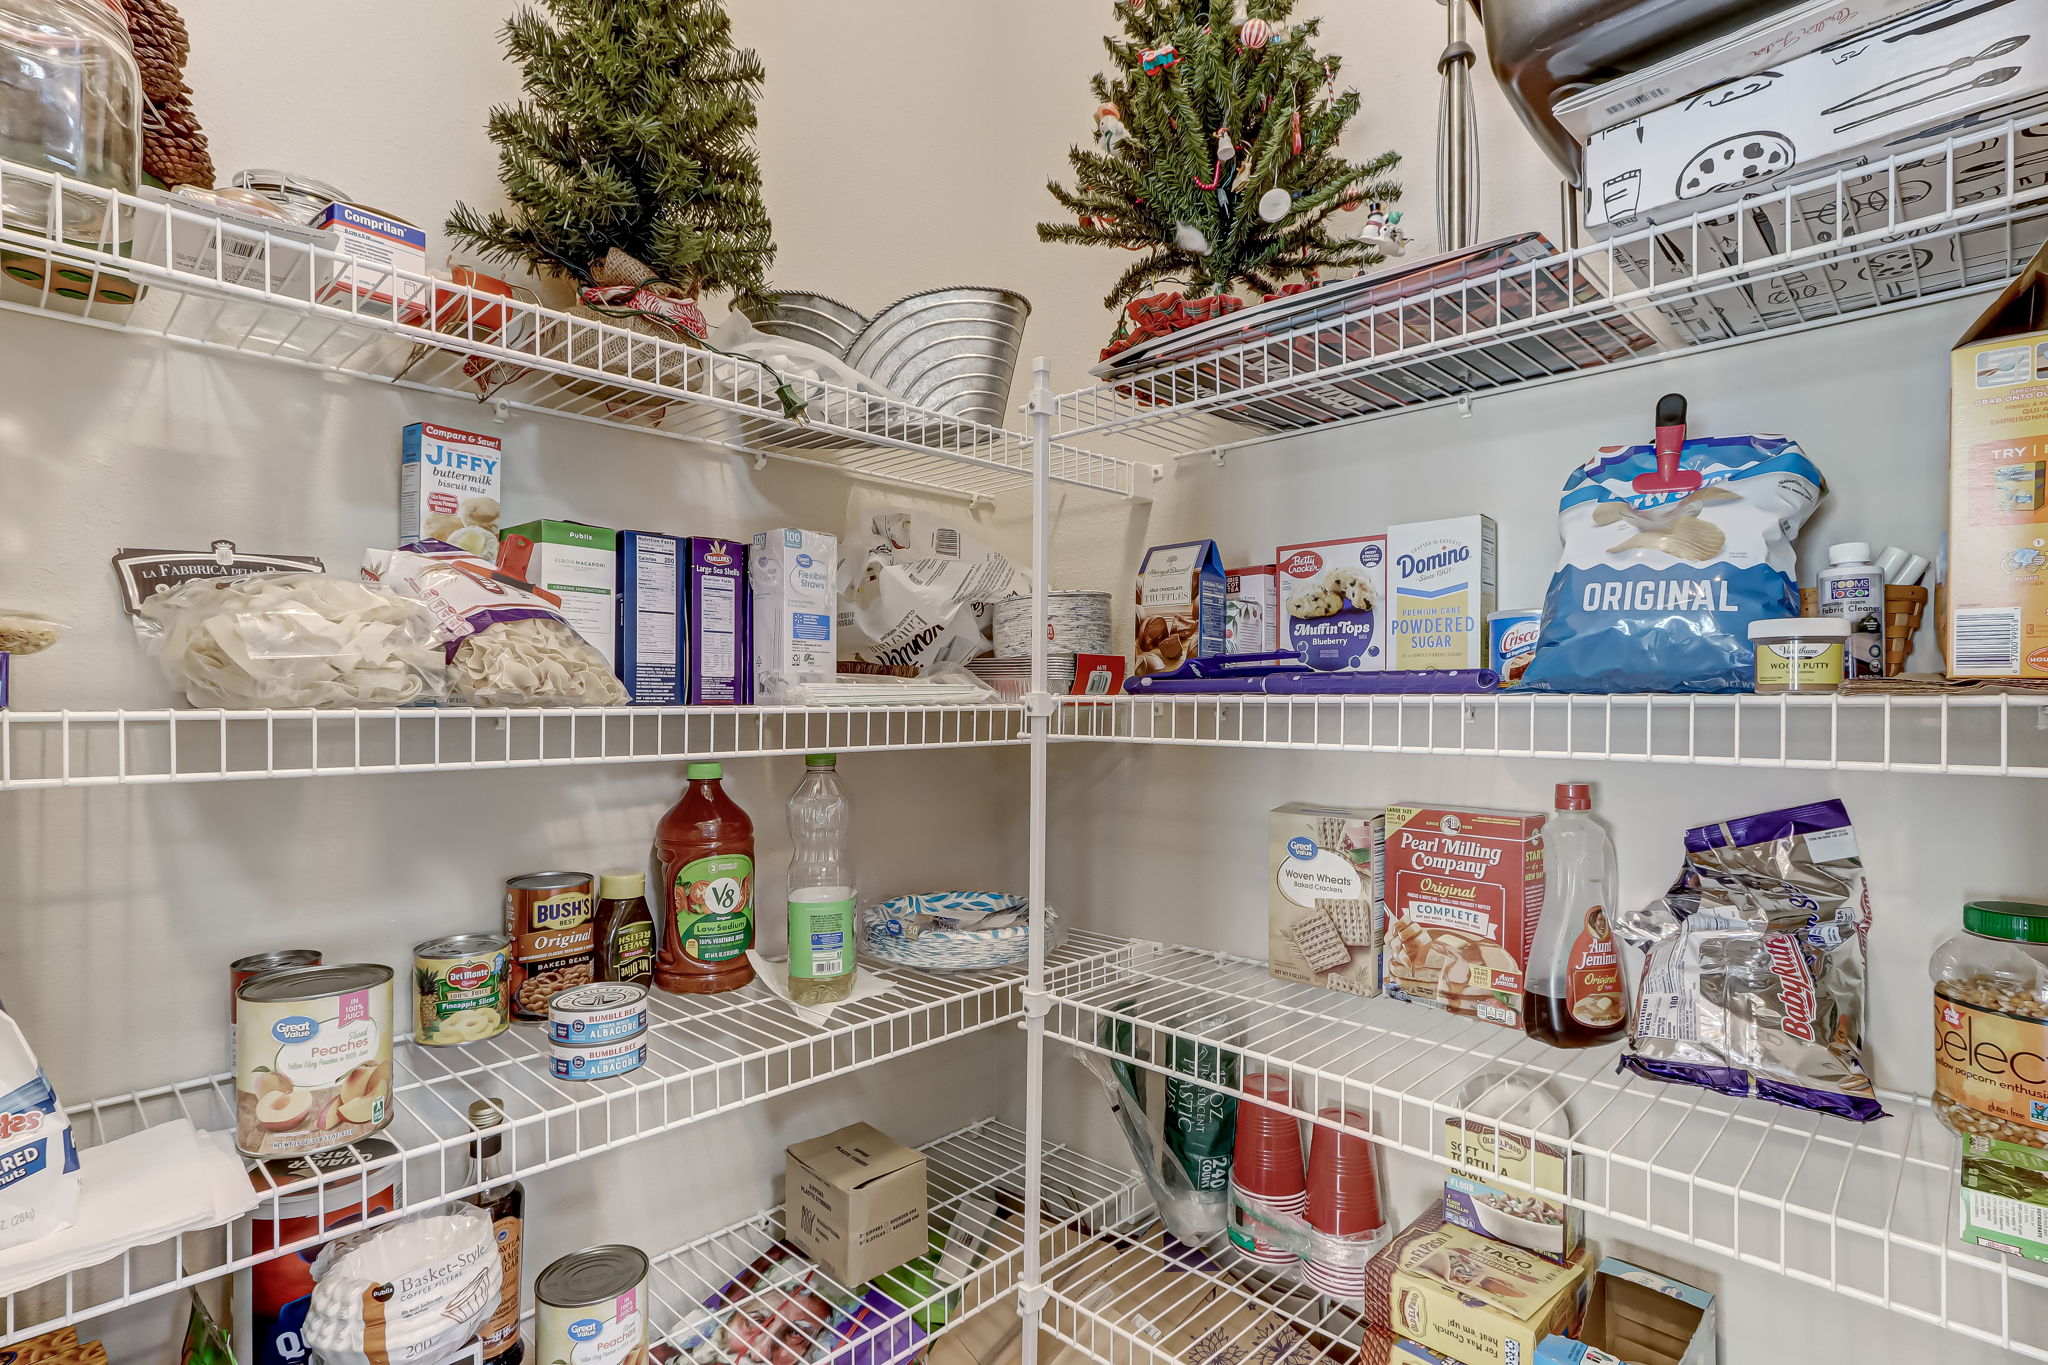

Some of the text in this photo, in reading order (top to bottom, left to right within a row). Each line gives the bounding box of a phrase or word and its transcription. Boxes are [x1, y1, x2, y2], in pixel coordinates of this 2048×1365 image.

[1750, 7, 1858, 56] Walter Foster
[344, 211, 406, 240] Comprilan
[2005, 392, 2034, 402] ONTO
[426, 425, 499, 449] Compare & Save!
[425, 444, 498, 475] JIFFY
[1991, 446, 2026, 461] TRY
[432, 466, 493, 486] buttermilk
[437, 479, 487, 494] biscuit mix
[569, 531, 593, 541] Publix
[786, 531, 801, 544] 100
[575, 559, 607, 569] MACARONI
[1293, 555, 1315, 567] Betty
[1396, 545, 1471, 579] Domino
[143, 562, 229, 579] LA FABBRICA
[696, 565, 741, 578] Large Sea Shells
[798, 570, 827, 581] Flexible
[1288, 565, 1320, 576] Crocker
[553, 585, 608, 595] COOKING INSTRUCTIONS
[801, 579, 825, 590] Straws
[1831, 578, 1869, 590] ROOMS
[1144, 591, 1189, 603] TRUFFLES
[1582, 579, 1739, 613] ORIGINAL
[1832, 589, 1864, 599] TO GO
[1402, 605, 1462, 616] PREMIUM CANE
[1822, 604, 1880, 615] fabric Cleaner
[896, 609, 916, 629] CLASSIC
[1391, 616, 1475, 636] POWDERED
[1294, 620, 1371, 638] Muffin Tops
[1312, 637, 1349, 647] Blueberry
[1411, 635, 1452, 650] SUGAR
[1803, 661, 1830, 670] PUTTY
[1396, 814, 1406, 822] 40
[1290, 842, 1313, 854] Great
[1294, 850, 1314, 859] Value
[1401, 831, 1502, 867] Pearl Milling
[1411, 851, 1488, 880] Company
[1285, 868, 1353, 887] Woven Wheats
[711, 882, 735, 908] V8
[1293, 880, 1344, 895] Baked Crackers
[1419, 877, 1477, 901] Original
[537, 897, 590, 924] BUSH'S
[1416, 903, 1480, 924] COMPLETE
[559, 918, 576, 926] BEST
[696, 920, 745, 933] Low Sodium
[534, 927, 592, 950] Original
[618, 930, 652, 946] RELISH
[618, 938, 650, 953] SWEET
[1588, 940, 1612, 956] Aunt
[537, 955, 590, 971] BAKED BEANS
[1575, 951, 1617, 970] Jemima
[450, 969, 488, 981] Del Monte
[621, 961, 638, 977] Olive
[344, 1003, 365, 1014] 100%
[349, 997, 361, 1005] IN
[442, 996, 496, 1011] Pineapple Slices
[343, 1010, 366, 1022] JUICE
[588, 1006, 637, 1023] BUMBLE BEE
[1638, 998, 1649, 1038] Nutrition
[276, 1020, 311, 1035] Great
[590, 1020, 638, 1039] ALBACORE
[1643, 1012, 1653, 1036] Facts
[283, 1030, 312, 1041] Value
[310, 1037, 369, 1058] Peaches
[589, 1042, 637, 1059] BUMBLE BEE
[590, 1056, 638, 1075] ALBACORE
[1954, 1066, 1997, 1086] popcorn
[1987, 1101, 2026, 1120] gluten free
[1201, 1159, 1213, 1189] COUNT
[1209, 1156, 1228, 1190] 240
[1449, 1178, 1475, 1193] FLOUR
[11, 1209, 37, 1228] (284g)
[1469, 1247, 1516, 1269] SEASONING
[1480, 1244, 1533, 1270] TACO
[399, 1241, 486, 1294] Basket-Style
[372, 1286, 395, 1299] Publix
[399, 1270, 464, 1303] COFFEE FILTERS
[570, 1322, 597, 1335] Great
[1447, 1319, 1461, 1330] up!
[576, 1330, 598, 1339] Value
[597, 1326, 637, 1352] Peaches
[1431, 1322, 1499, 1359] For Max Crunch,
[1479, 1333, 1499, 1347] heat
[405, 1337, 434, 1359] 200
